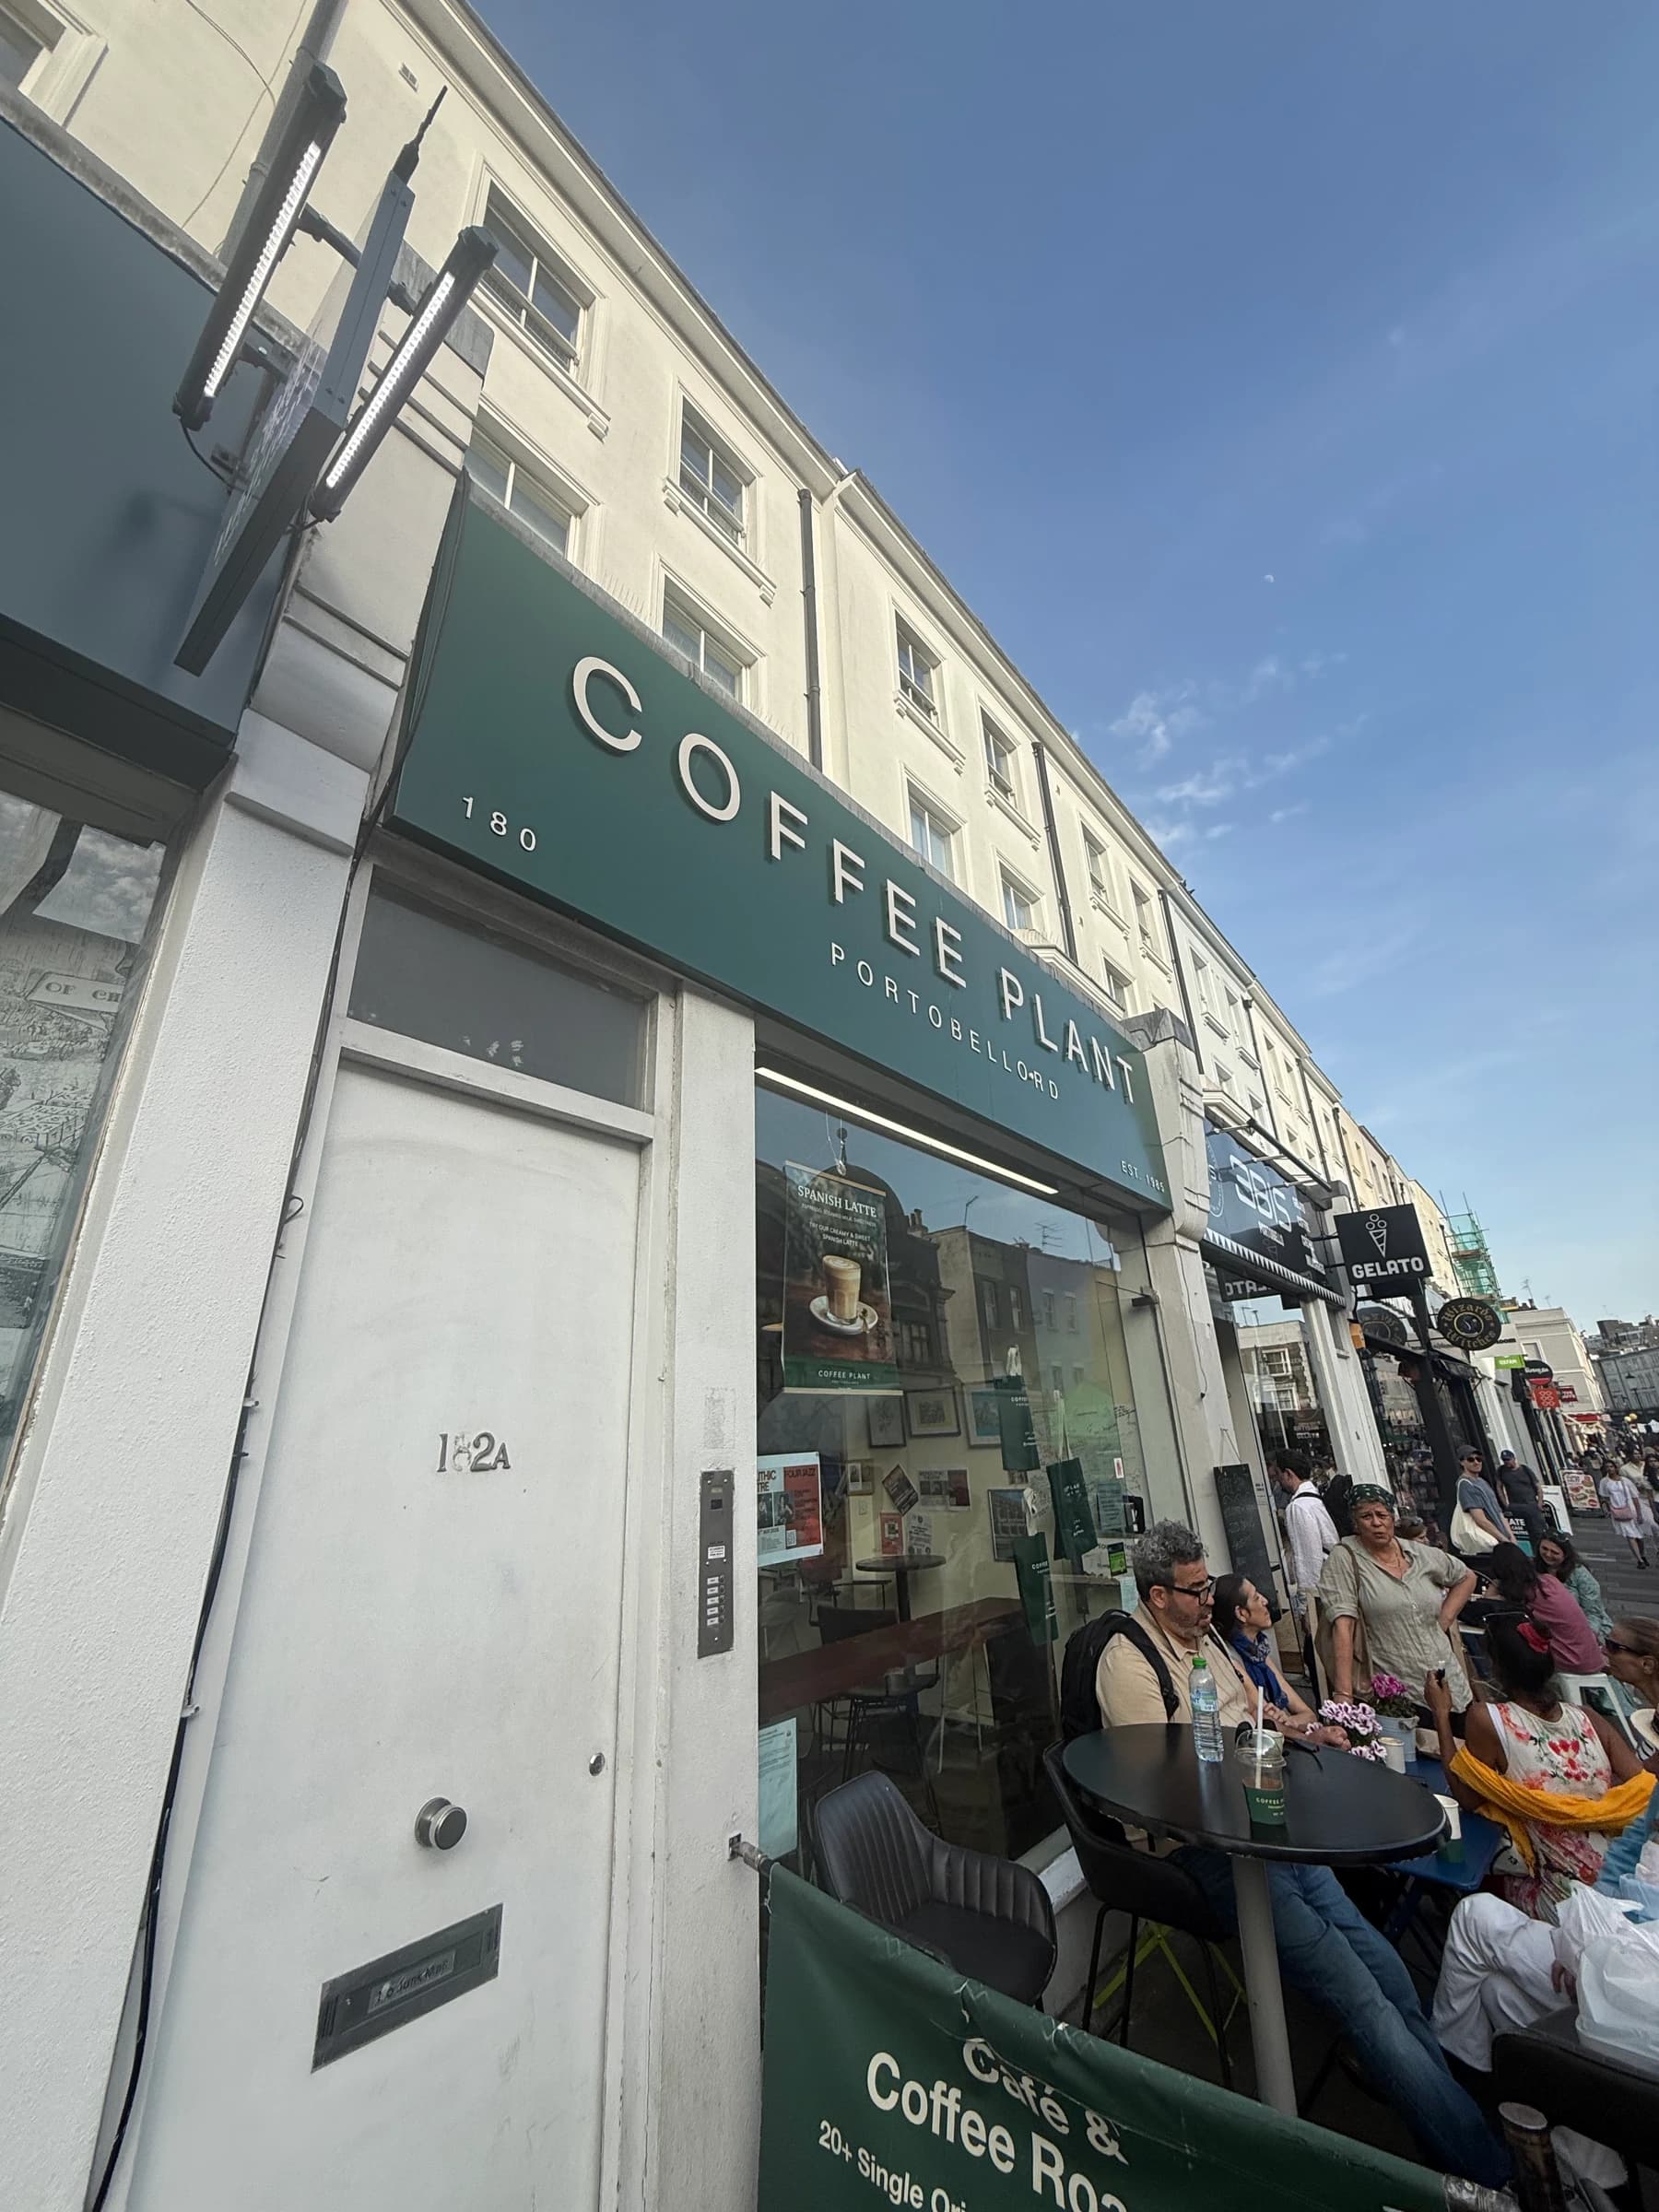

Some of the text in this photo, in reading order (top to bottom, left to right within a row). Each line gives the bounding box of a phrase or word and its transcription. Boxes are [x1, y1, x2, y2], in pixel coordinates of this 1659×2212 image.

[462, 796, 536, 852] 180
[573, 656, 1134, 1104] COFFEE PLANT
[831, 942, 1059, 1100] PORTOBELLO RD
[797, 1184, 877, 1218] SPANISH LATTE
[1351, 1256, 1425, 1279] GELATO
[818, 1370, 871, 1380] COFFEE PLANT
[867, 2052, 1015, 2174] Coffee
[1085, 2108, 1129, 2166] &
[818, 2119, 853, 2163] 20+
[857, 2147, 924, 2209] Single
